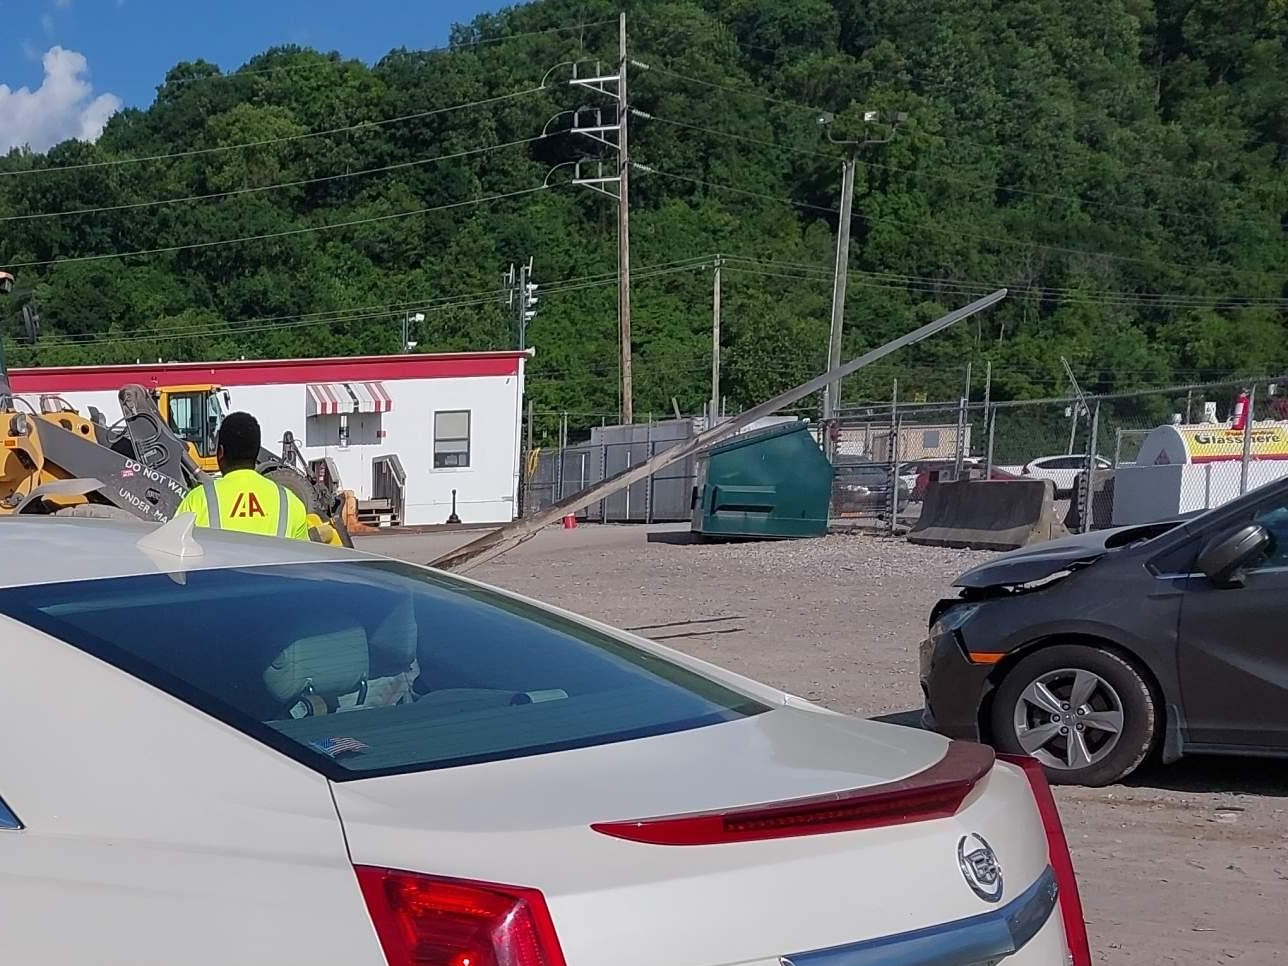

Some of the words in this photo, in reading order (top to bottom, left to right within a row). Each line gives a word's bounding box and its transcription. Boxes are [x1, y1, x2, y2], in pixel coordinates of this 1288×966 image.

[125, 460, 141, 472] DO
[143, 467, 166, 484] NOT
[119, 488, 150, 513] UNDER
